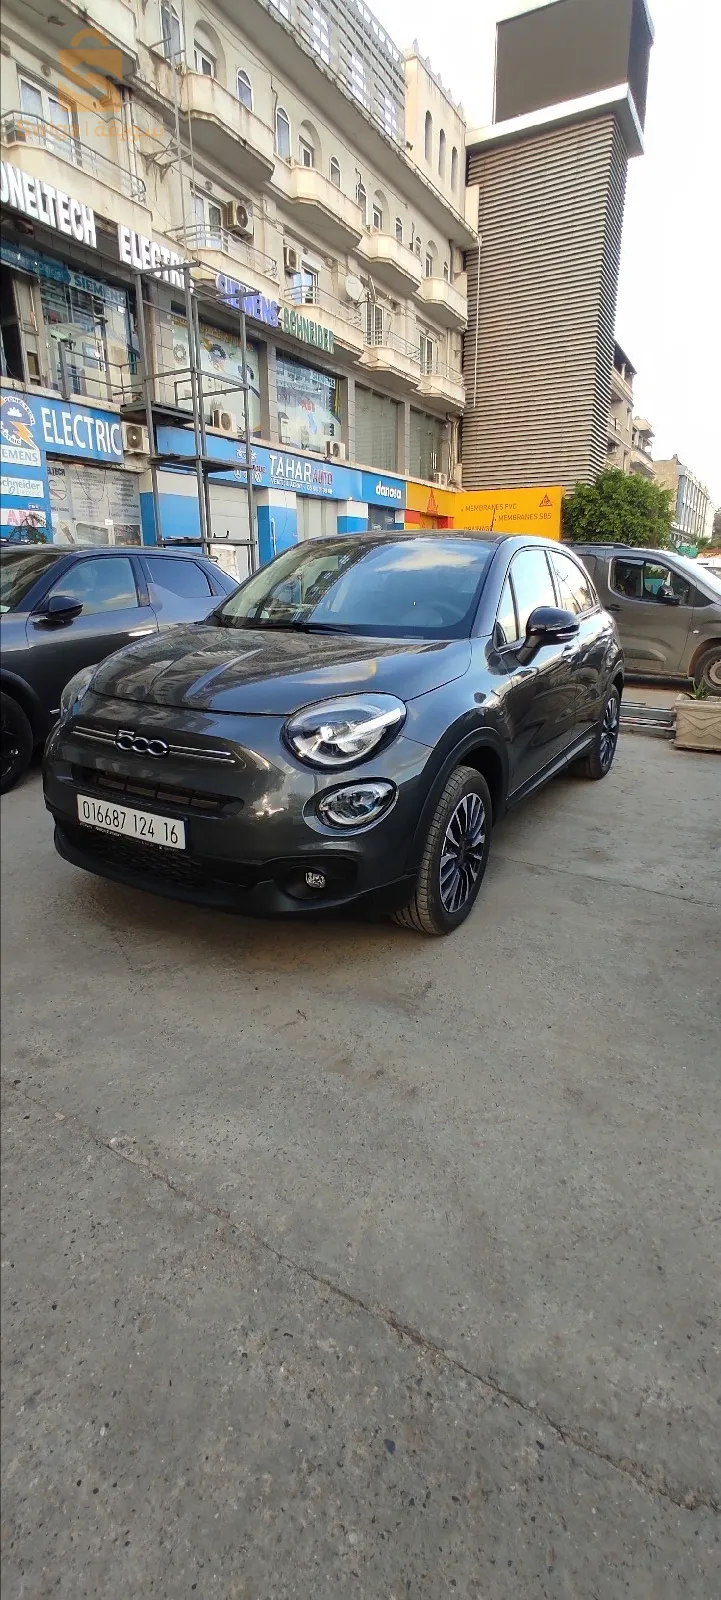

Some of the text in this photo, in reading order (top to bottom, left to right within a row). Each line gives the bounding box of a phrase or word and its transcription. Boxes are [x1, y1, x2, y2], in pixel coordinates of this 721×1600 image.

[74, 274, 125, 303] SIEMENS
[216, 273, 280, 328] SIEMENS
[281, 306, 334, 355] SCHNEIDER
[41, 406, 121, 456] ELECTRIC
[0, 475, 41, 490] chneider
[270, 455, 333, 486] TAHAR AUTO
[375, 480, 402, 499] danosa
[465, 504, 504, 512] MEMBRANES
[498, 513, 538, 522] MEMBRANES
[115, 729, 169, 756] 500
[82, 800, 127, 830] 016687
[133, 813, 155, 838] 124
[163, 822, 178, 844] 16
